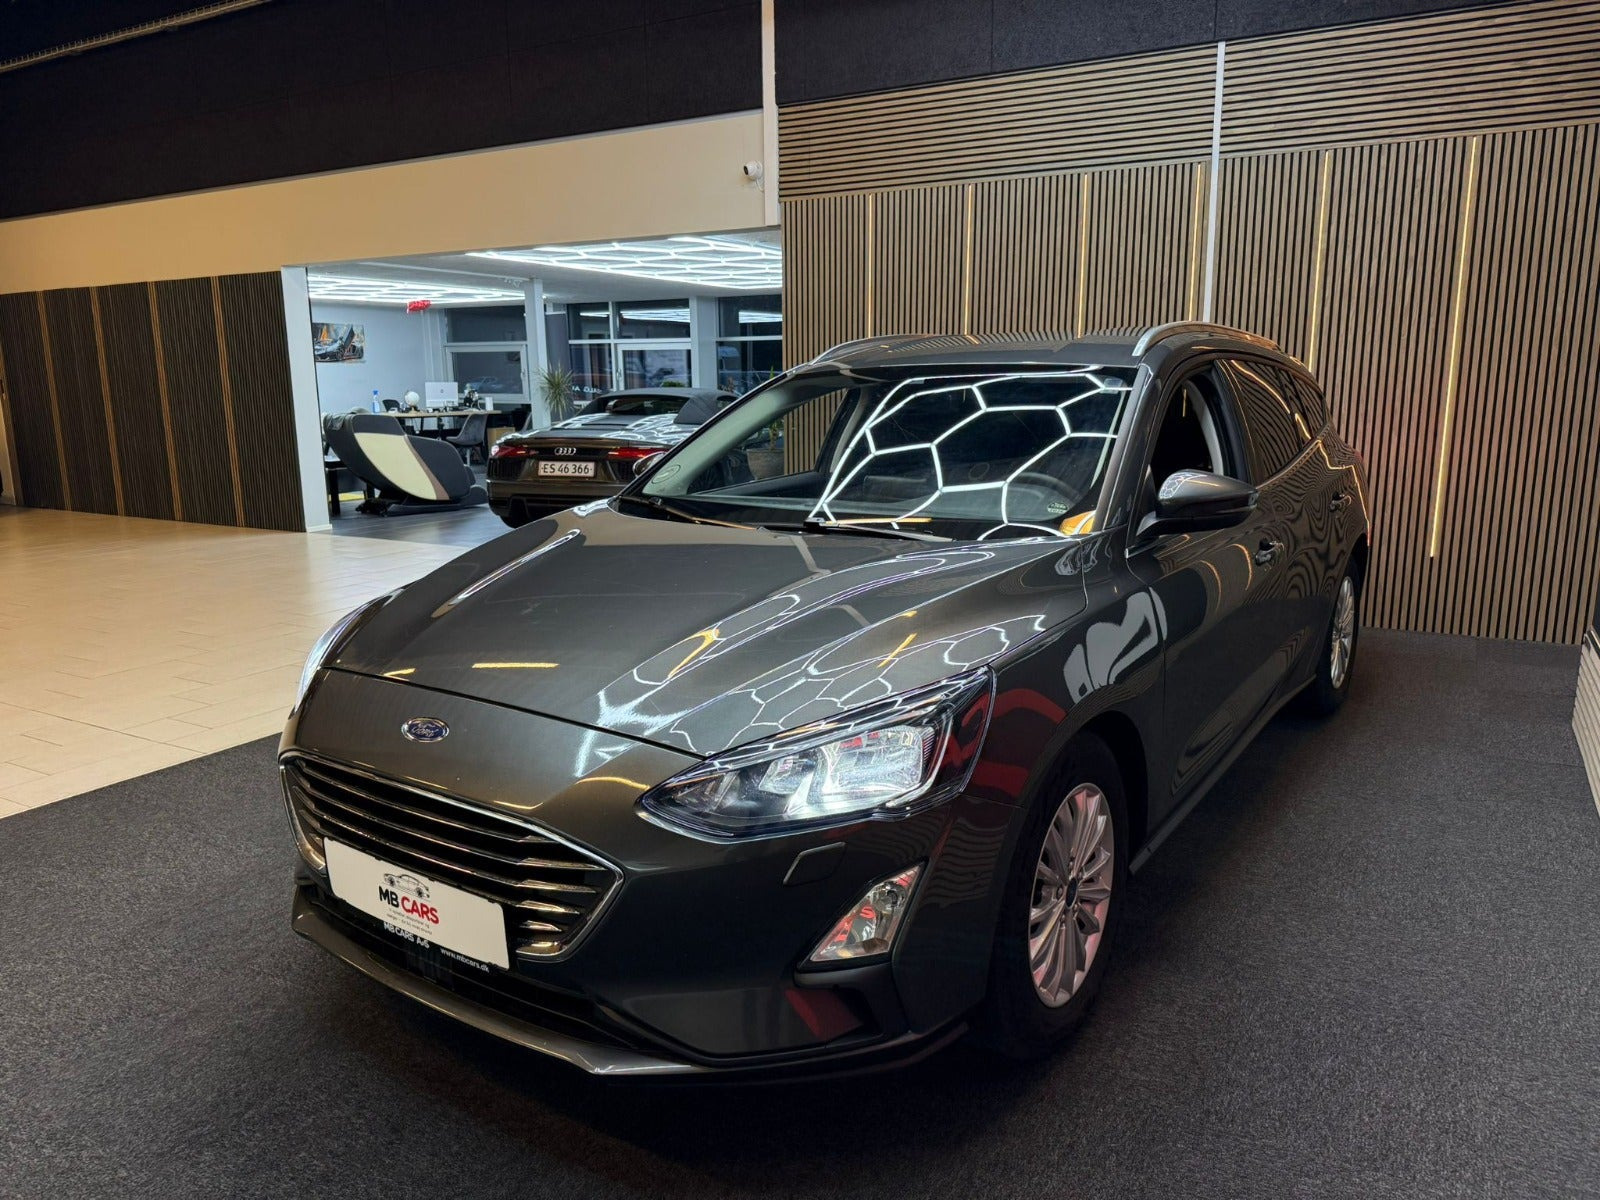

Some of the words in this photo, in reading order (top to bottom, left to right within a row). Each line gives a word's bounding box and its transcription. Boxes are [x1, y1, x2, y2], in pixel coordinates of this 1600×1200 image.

[543, 463, 556, 474] ES
[557, 463, 570, 474] 46
[571, 463, 590, 475] 366
[378, 885, 399, 908] MB
[401, 895, 439, 924] CARS
[395, 927, 415, 942] CARS
[440, 948, 490, 973] www.mbcars.dk
